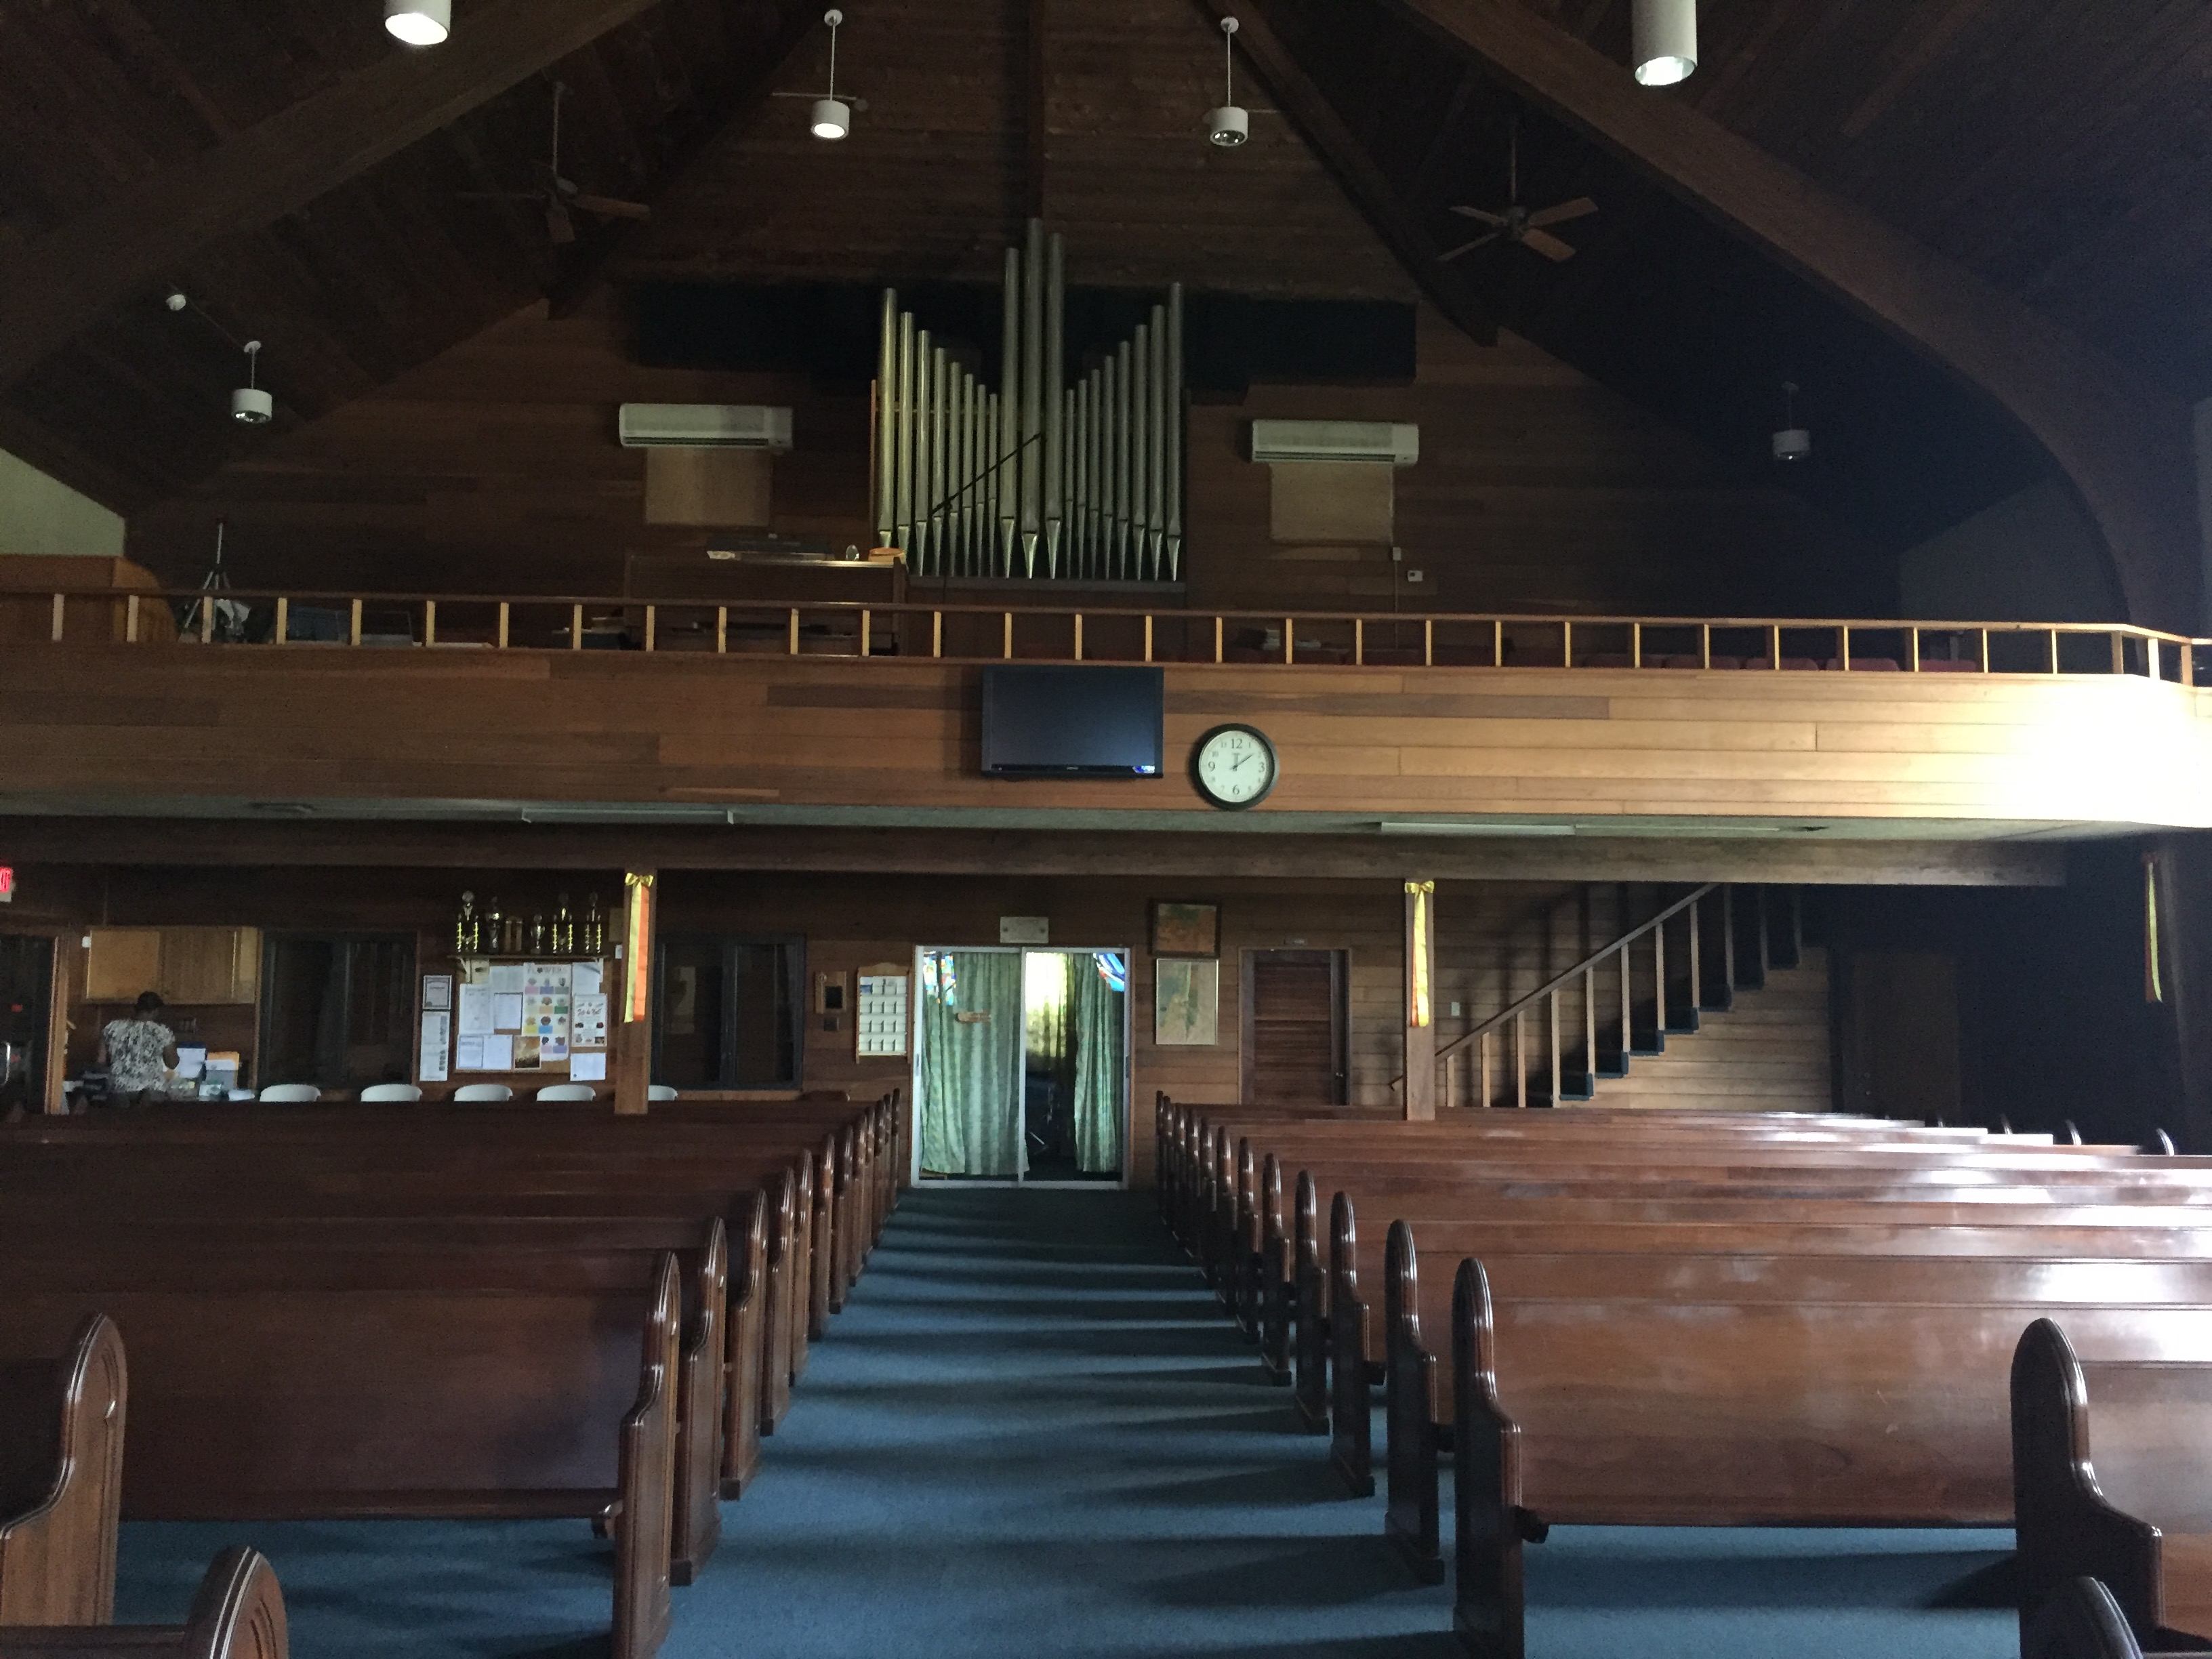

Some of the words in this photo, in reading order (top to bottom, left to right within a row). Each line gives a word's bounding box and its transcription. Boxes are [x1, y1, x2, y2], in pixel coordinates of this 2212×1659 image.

[1231, 739, 1243, 749] 12
[1208, 761, 1216, 772] 9
[1258, 762, 1265, 773] 3
[1232, 784, 1240, 795] 6
